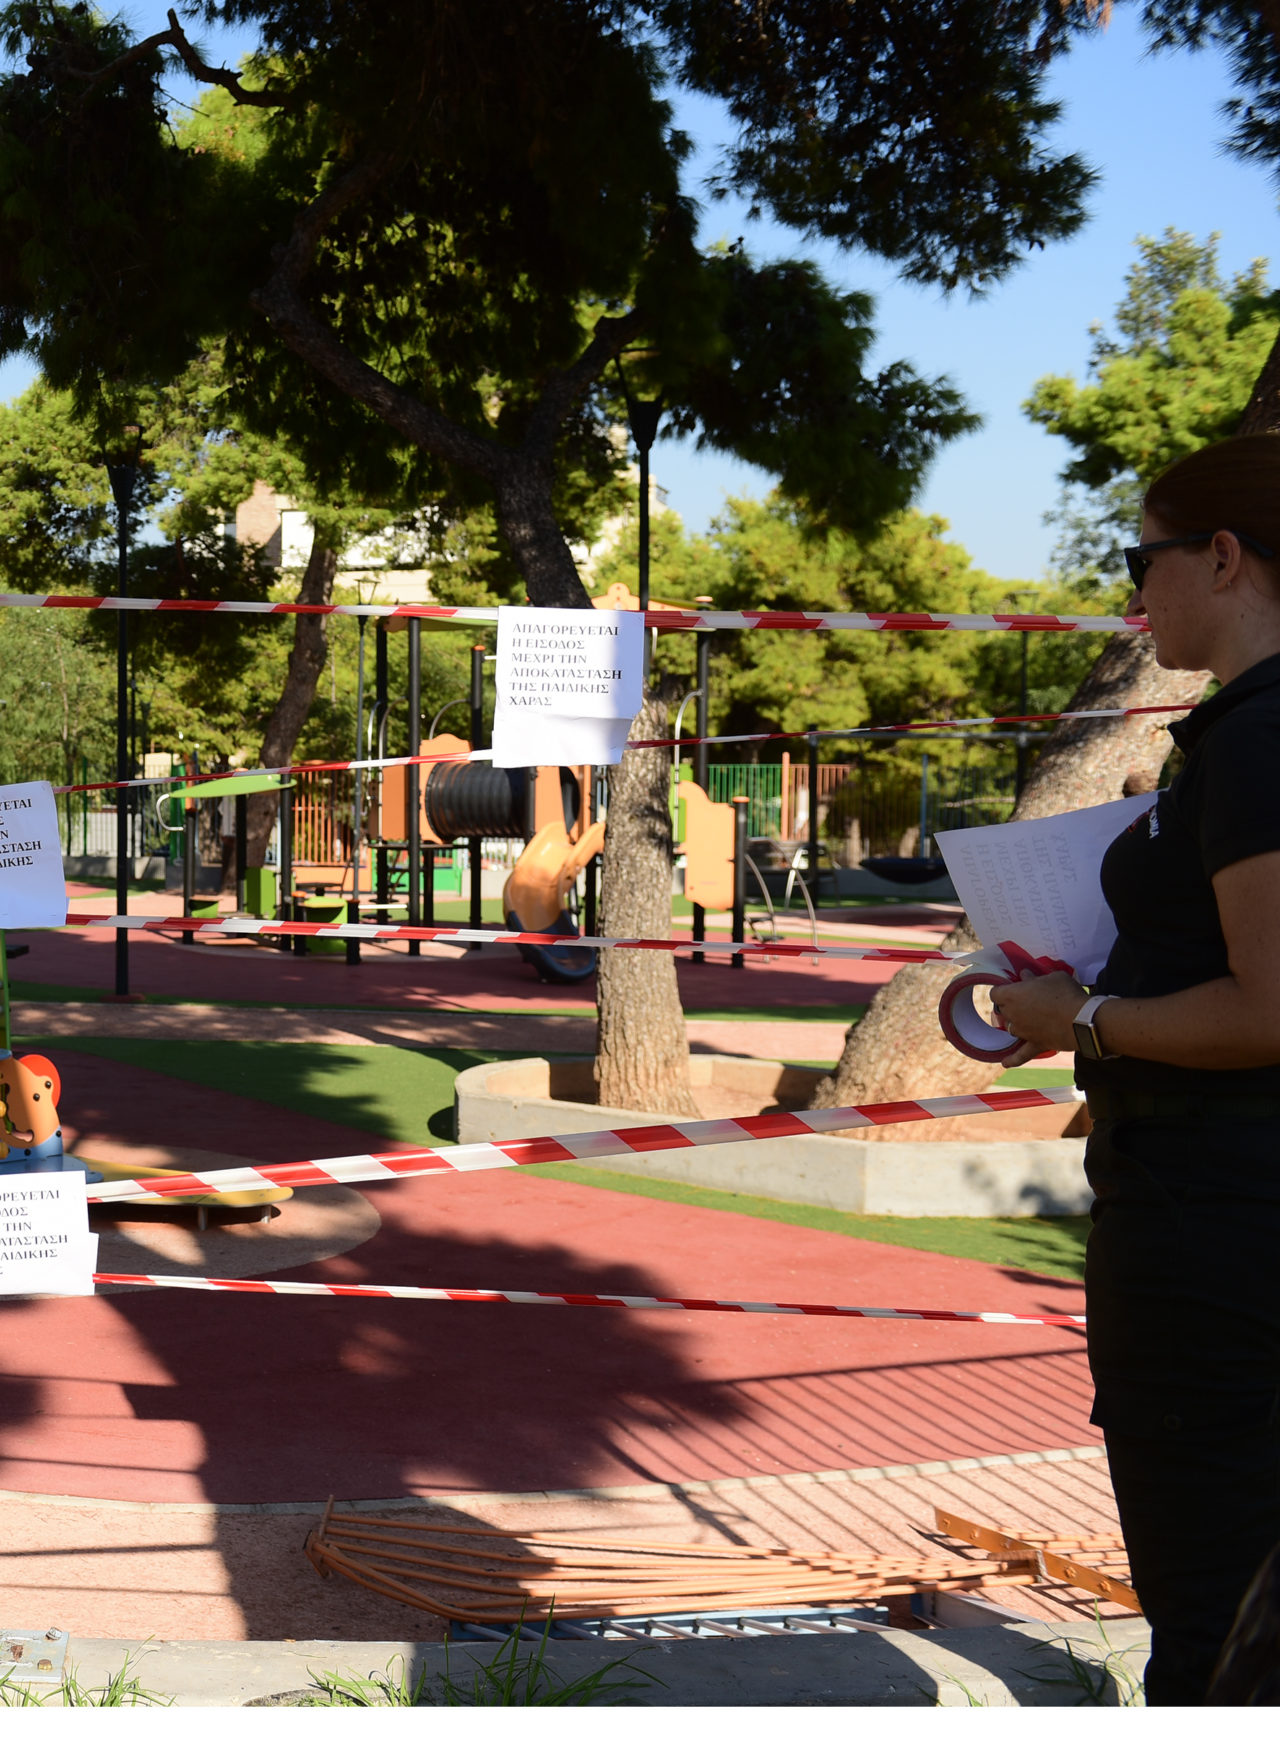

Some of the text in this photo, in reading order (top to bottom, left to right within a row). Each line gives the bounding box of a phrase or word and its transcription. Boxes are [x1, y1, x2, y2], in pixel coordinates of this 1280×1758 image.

[512, 623, 620, 636] ΑΠΑΓΟΡΕΥΕΤΑΙ
[512, 638, 585, 650] Η ΕΙΣΟΔΟΣ
[511, 653, 587, 664] ΜΕΧΡΙ ΤΗΝ
[510, 667, 622, 679] ΑΠΟΚΑΤΑΣΤΑΣΗ
[509, 682, 609, 694] ΤΗΣ ΠΑΙΔΙΚΗΣ
[508, 695, 552, 706] ΧΑΡΑΣ
[2, 1221, 32, 1232] ΤΗΝ
